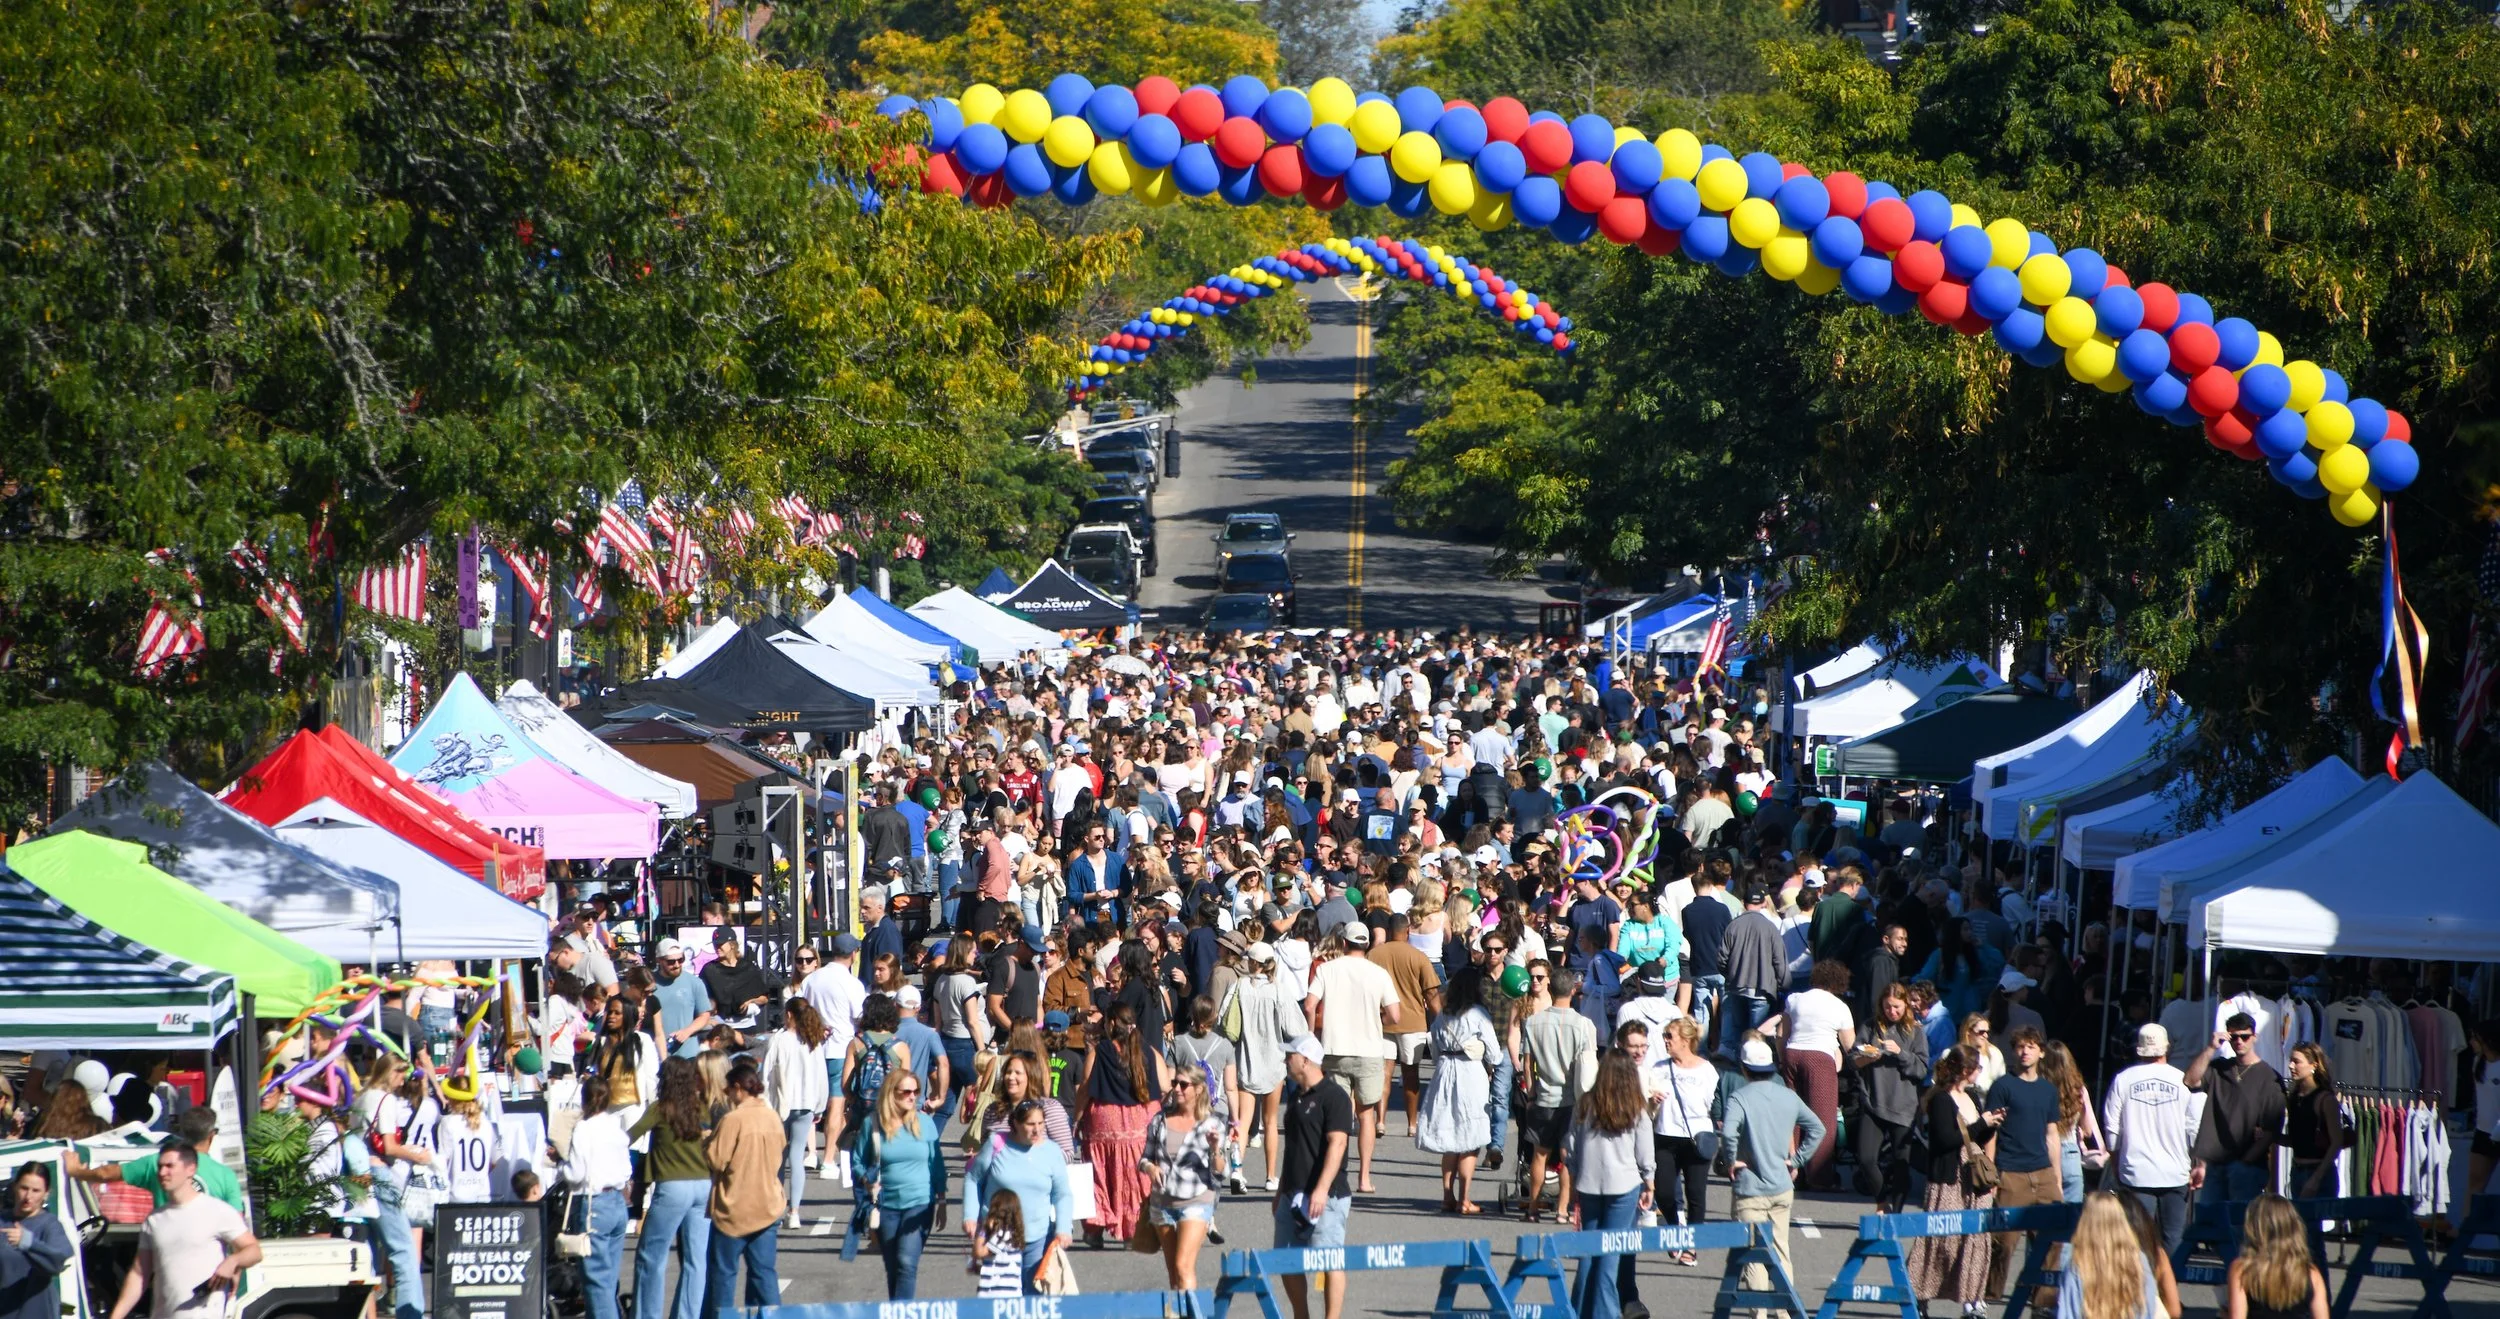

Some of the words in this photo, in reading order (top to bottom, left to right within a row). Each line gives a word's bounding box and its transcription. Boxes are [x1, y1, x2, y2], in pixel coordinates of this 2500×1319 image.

[1014, 600, 1091, 609] BROADWAY
[490, 827, 537, 846] CH
[163, 1013, 190, 1025] ABC
[458, 1137, 486, 1172] 10
[454, 1216, 520, 1231] SEAPORT
[1927, 1213, 1962, 1234] BOSTON
[462, 1230, 519, 1244] MEDSPA
[1602, 1230, 1642, 1253] BOSTON
[1660, 1227, 1695, 1249] POLICE
[447, 1251, 476, 1264] FREE
[479, 1250, 511, 1263] YEAR
[513, 1250, 532, 1263] OF
[1303, 1248, 1345, 1271] BOSTON
[1367, 1245, 1405, 1267] POLICE
[451, 1264, 526, 1284] BOTOX
[1853, 1285, 1880, 1300] BPD
[878, 1301, 957, 1319] BOSTON
[993, 1298, 1062, 1319] POLICE
